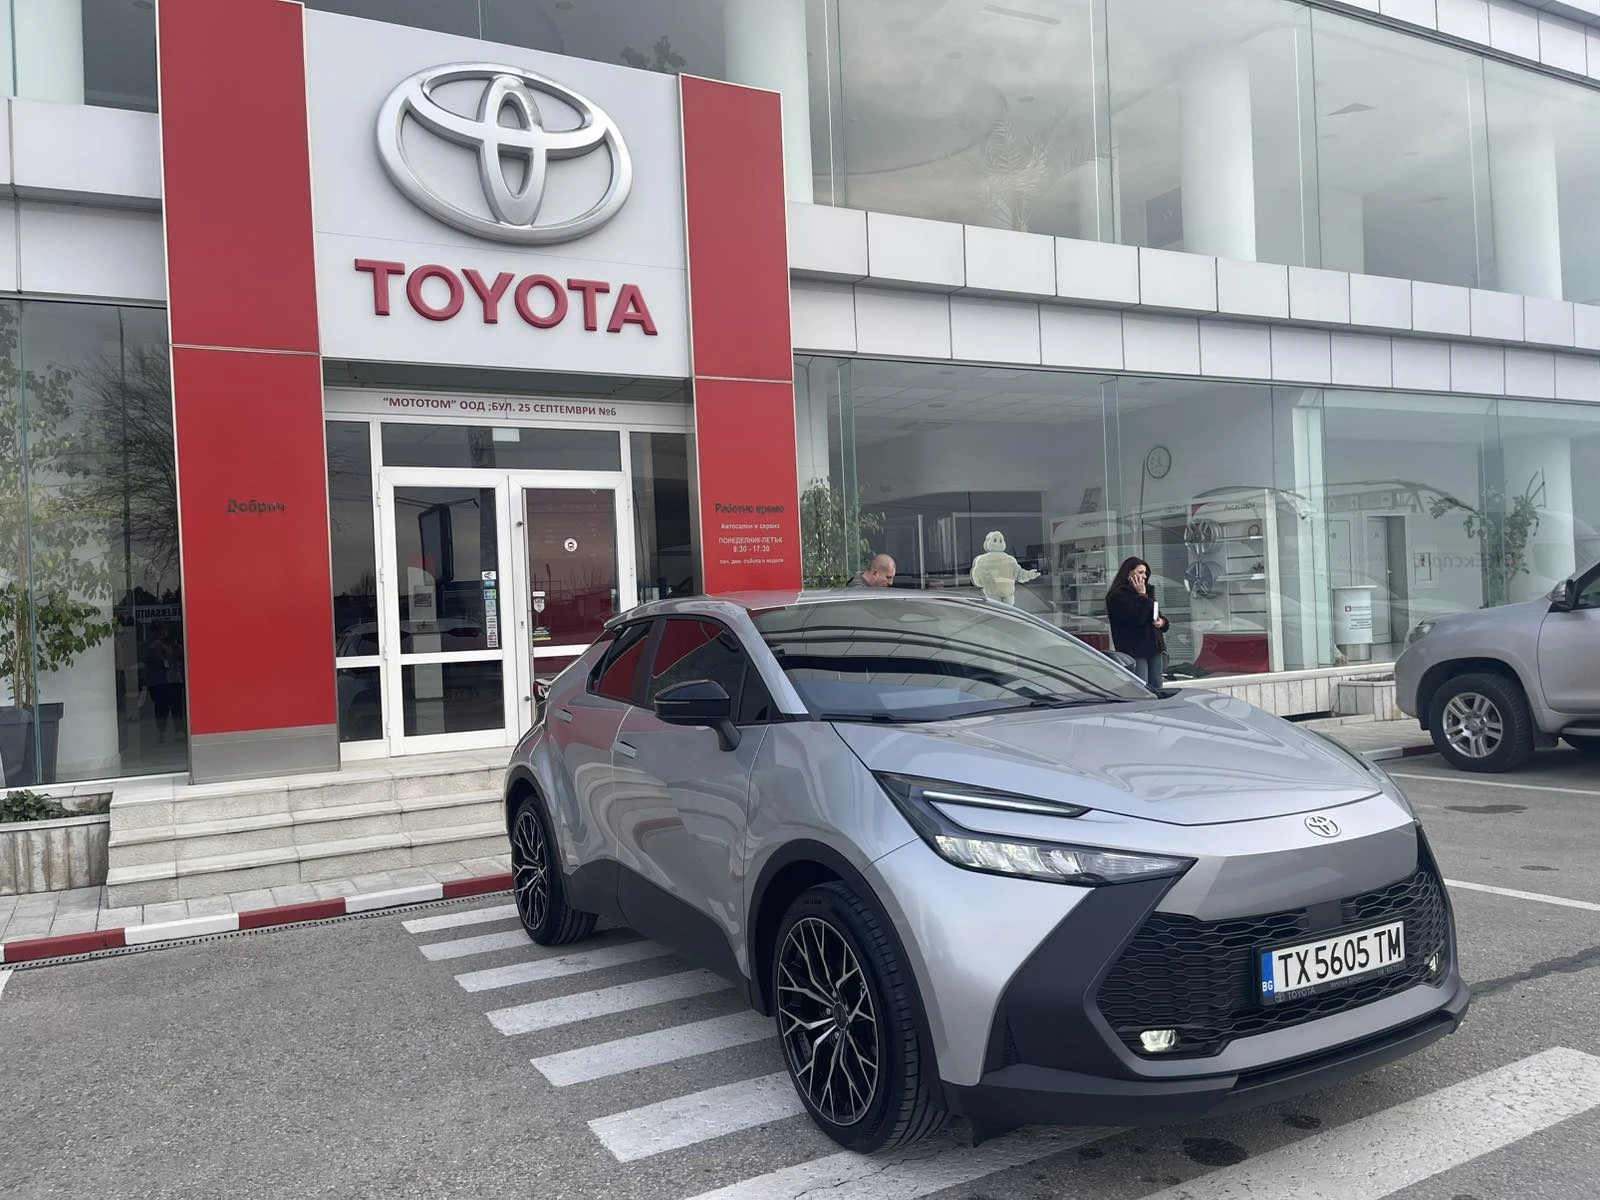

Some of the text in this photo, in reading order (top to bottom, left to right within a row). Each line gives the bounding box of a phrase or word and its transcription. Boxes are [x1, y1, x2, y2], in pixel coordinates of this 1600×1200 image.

[354, 258, 658, 336] TOYOTA
[460, 400, 485, 411] ООД
[518, 403, 531, 412] 25
[533, 404, 596, 415] СЕПТЕМВРИ
[598, 407, 617, 416] №6
[227, 498, 286, 515] Добрич
[715, 503, 784, 514] Работно време
[719, 536, 783, 544] ПОНЕДЕЛНИК-ПЕТЪК
[733, 545, 747, 553] 8:30
[753, 545, 770, 553] 17:30
[1314, 935, 1370, 980] 5605
[1373, 926, 1401, 963] TM
[1262, 979, 1274, 993] BG
[1287, 988, 1315, 1000] TOYOTA
